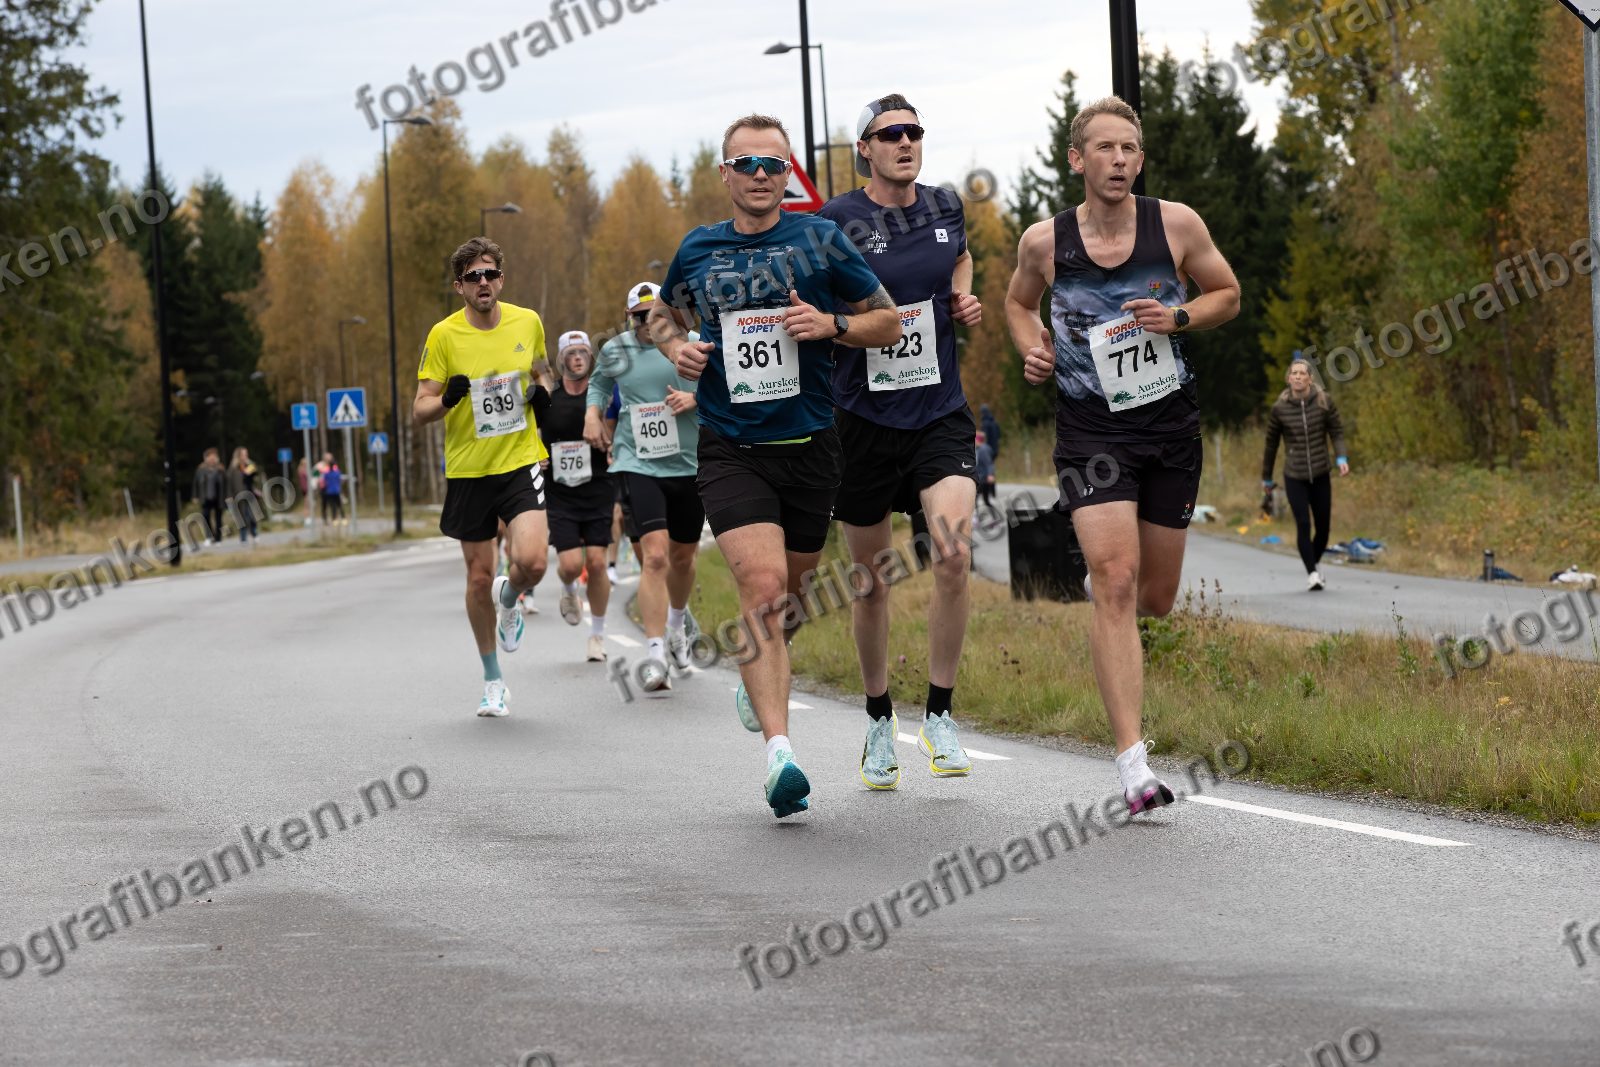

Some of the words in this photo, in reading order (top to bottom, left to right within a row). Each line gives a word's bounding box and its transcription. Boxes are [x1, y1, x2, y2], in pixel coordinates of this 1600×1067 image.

[737, 315, 783, 326] NORGES
[898, 308, 922, 320] RGES
[741, 324, 776, 334] LØPET
[1104, 319, 1144, 338] NORGE
[1110, 326, 1144, 345] LØPET
[737, 339, 783, 370] 361
[880, 331, 923, 360] 423
[1107, 340, 1158, 378] 774
[897, 365, 937, 379] Aurskog
[758, 377, 799, 390] Aurskog
[1137, 373, 1177, 394] Aurskog
[482, 393, 515, 415] 639
[640, 420, 668, 438] 460
[560, 455, 584, 470] 576
